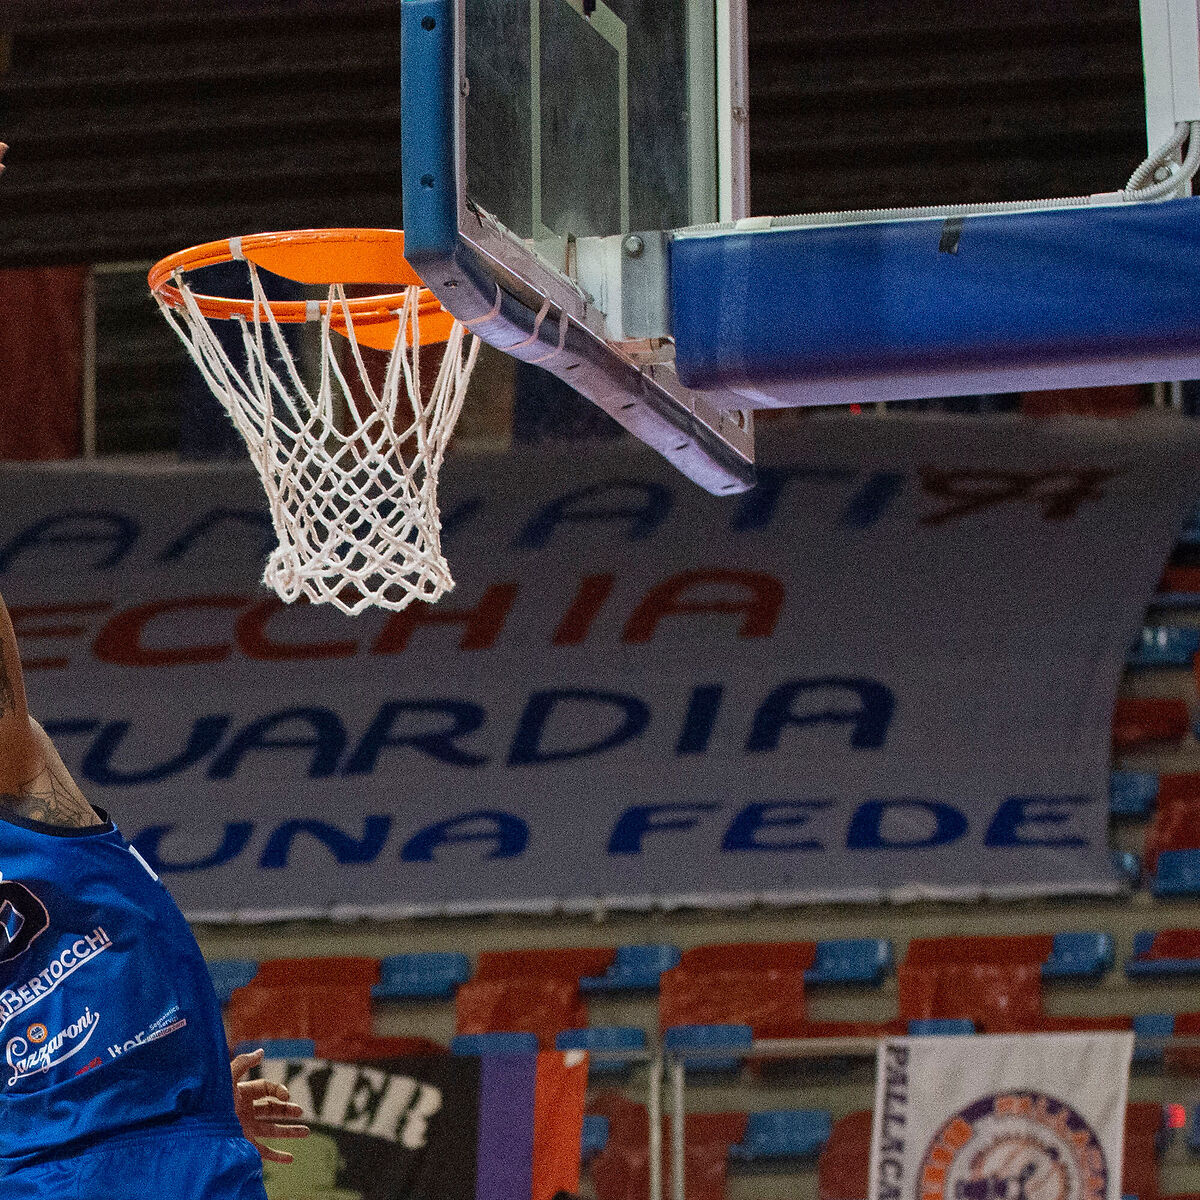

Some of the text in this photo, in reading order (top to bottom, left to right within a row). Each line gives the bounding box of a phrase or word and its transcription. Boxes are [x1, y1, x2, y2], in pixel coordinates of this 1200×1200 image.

[44, 674, 896, 786] UARDIA
[606, 796, 1092, 857] FEDE
[255, 1056, 443, 1151] KER
